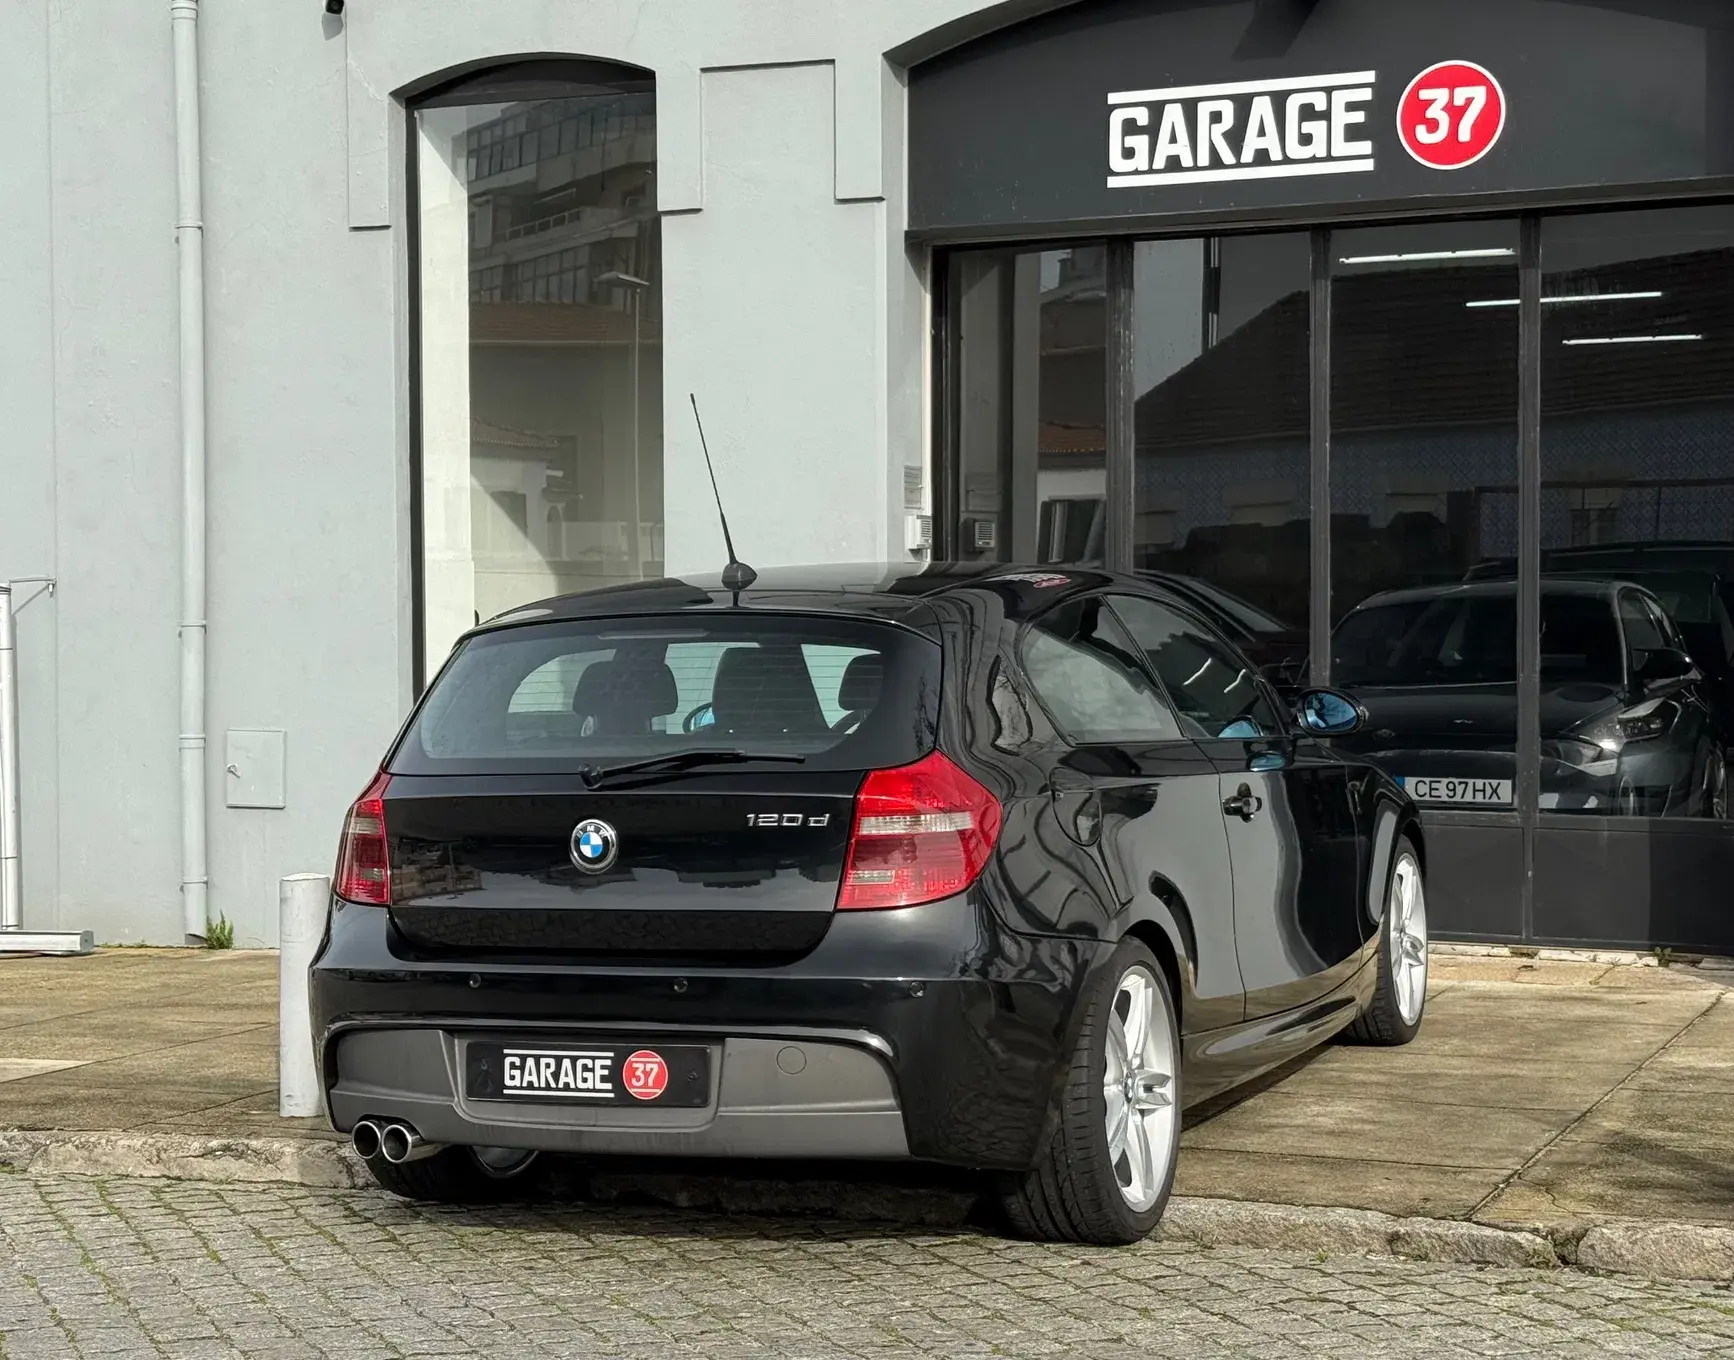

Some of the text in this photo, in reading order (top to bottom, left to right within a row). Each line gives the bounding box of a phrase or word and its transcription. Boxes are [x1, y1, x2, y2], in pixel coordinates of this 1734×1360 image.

[1108, 85, 1487, 173] GARAGE 37
[576, 825, 608, 839] BMW
[504, 1056, 659, 1090] GARAGE 37
